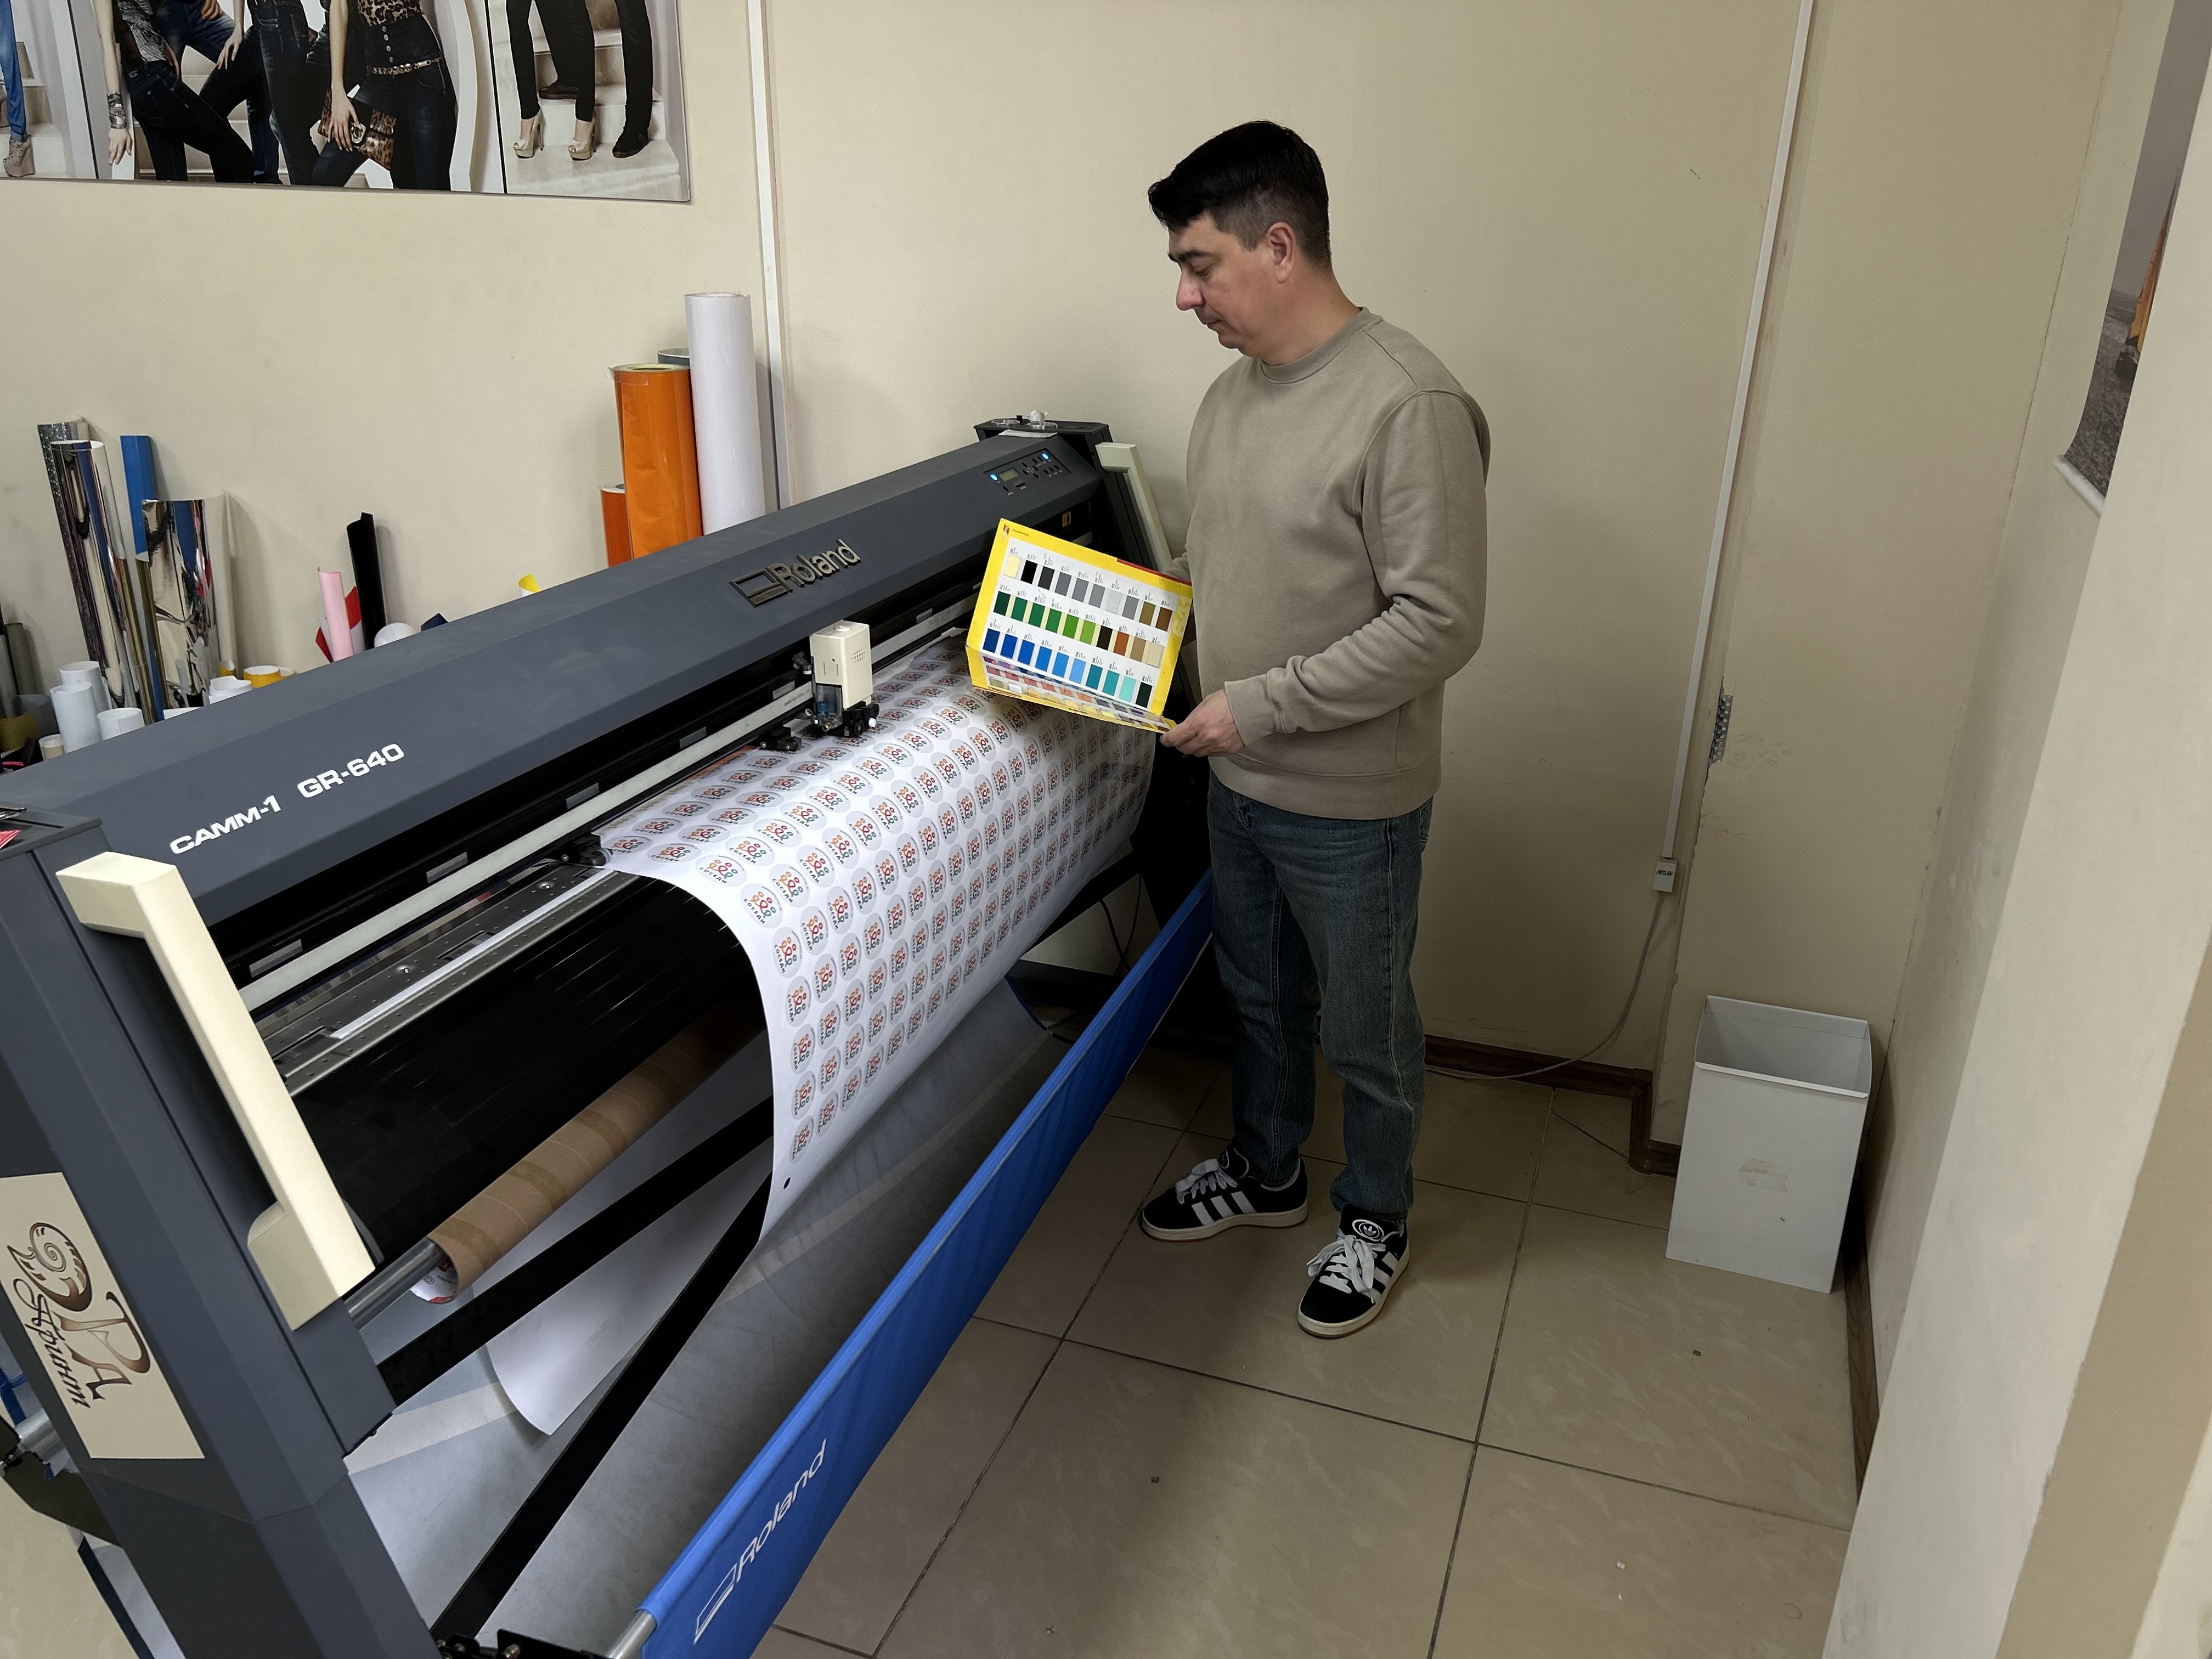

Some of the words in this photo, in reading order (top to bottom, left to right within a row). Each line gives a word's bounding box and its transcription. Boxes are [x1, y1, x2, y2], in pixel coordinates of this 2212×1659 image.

[765, 539, 861, 593] Roland
[917, 725, 939, 737] СОСЕДИ
[987, 725, 1002, 744] СОСЕДИ
[898, 738, 919, 751] СОСЕДИ
[970, 737, 985, 757] СОСЕДИ
[877, 751, 900, 764] СОСЕДИ
[952, 749, 968, 770] СОСЕДИ
[856, 765, 879, 778] СОСЕДИ
[934, 763, 950, 783] СОСЕДИ
[833, 780, 857, 794] СОСЕДИ
[914, 777, 931, 798] СОСЕДИ
[170, 795, 282, 855] CAMM-1
[297, 743, 405, 799] GR-640
[809, 795, 834, 810] СОСЕДИ
[894, 792, 911, 813] СОСЕДИ
[784, 812, 810, 827] СОСЕДИ
[872, 807, 890, 830] СОСЕДИ
[757, 829, 783, 844] СОСЕДИ
[849, 823, 867, 846] СОСЕДИ
[729, 848, 756, 863] СОСЕДИ
[825, 840, 844, 864] СОСЕДИ
[898, 848, 907, 873] СОСЕДИ
[699, 867, 727, 883] СОСЕДИ
[800, 859, 819, 883] СОСЕДИ
[876, 865, 885, 891] СОСЕДИ
[772, 878, 793, 902] СОСЕДИ
[853, 883, 862, 910] СОСЕДИ
[744, 899, 765, 924] СОСЕДИ
[828, 902, 838, 929] СОСЕДИ
[802, 923, 812, 951] СОСЕДИ
[774, 944, 785, 973] СОСЕДИ
[737, 1438, 827, 1583] Roland
